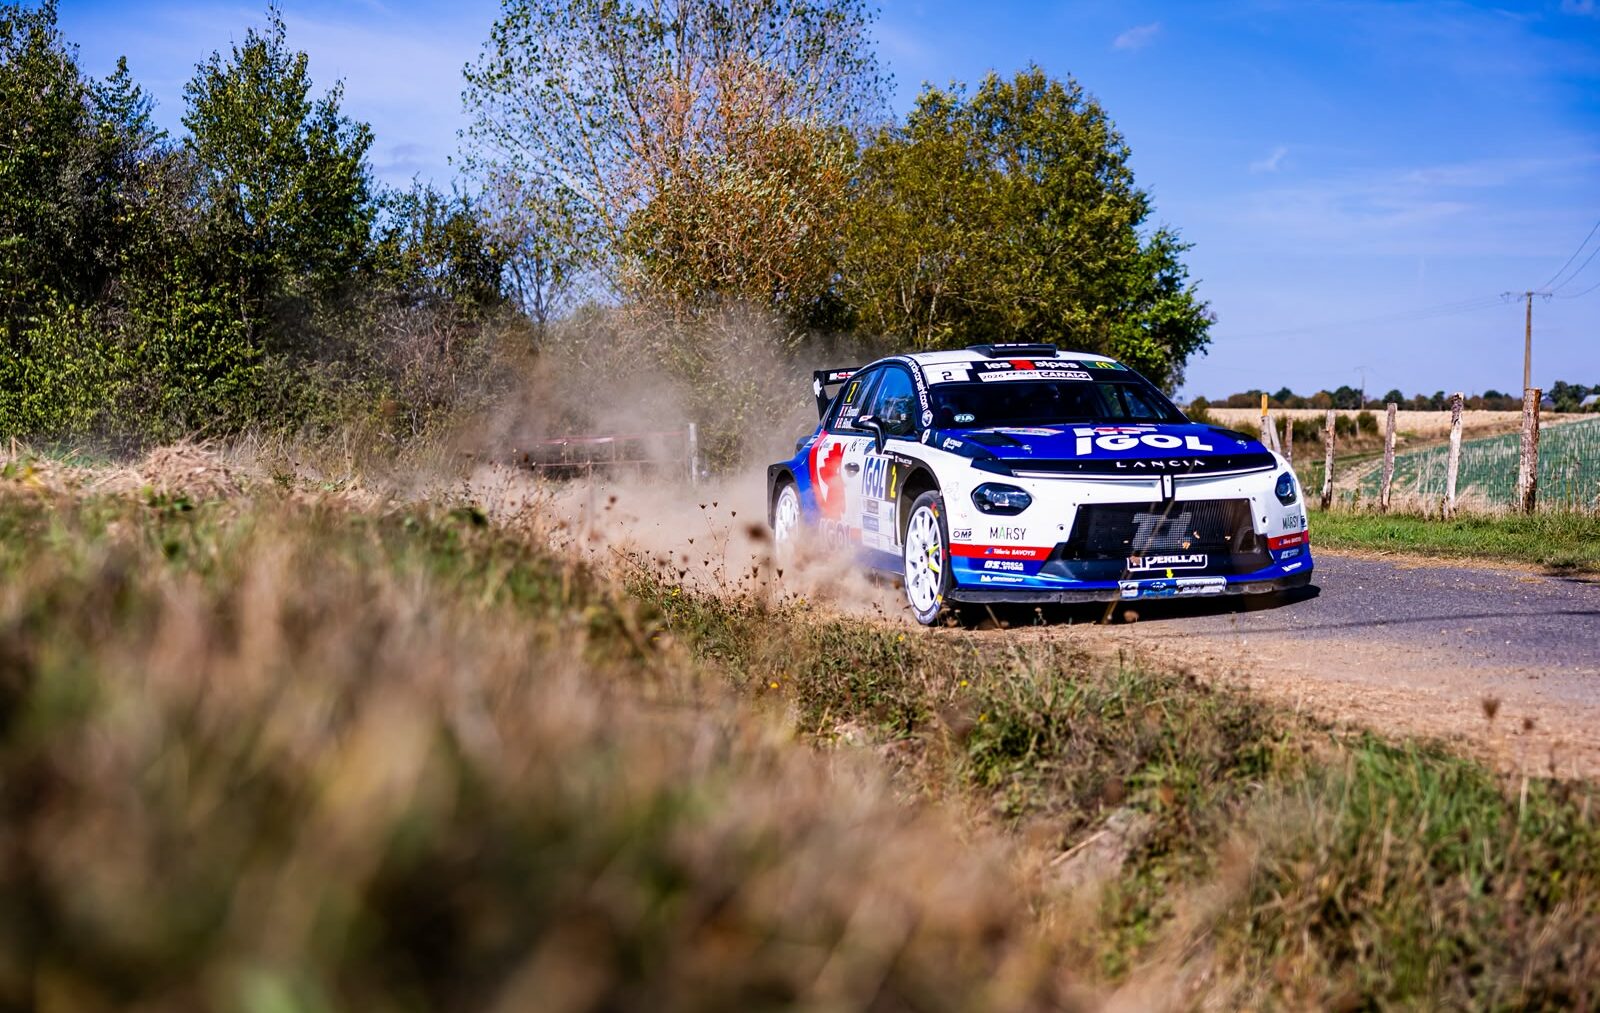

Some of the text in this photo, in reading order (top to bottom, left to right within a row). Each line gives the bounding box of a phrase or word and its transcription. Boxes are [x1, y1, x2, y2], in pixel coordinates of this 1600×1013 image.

[984, 361, 1012, 370] les
[1033, 361, 1080, 370] alpes
[941, 371, 954, 381] 2
[1041, 371, 1088, 379] CANAL+
[1073, 427, 1213, 456] IGOL
[1115, 460, 1206, 469] LANCIA
[862, 457, 887, 499] IGOL
[890, 464, 897, 499] 2
[1282, 515, 1300, 530] MARSY
[953, 530, 973, 539] OMP
[989, 526, 1027, 541] MARSY
